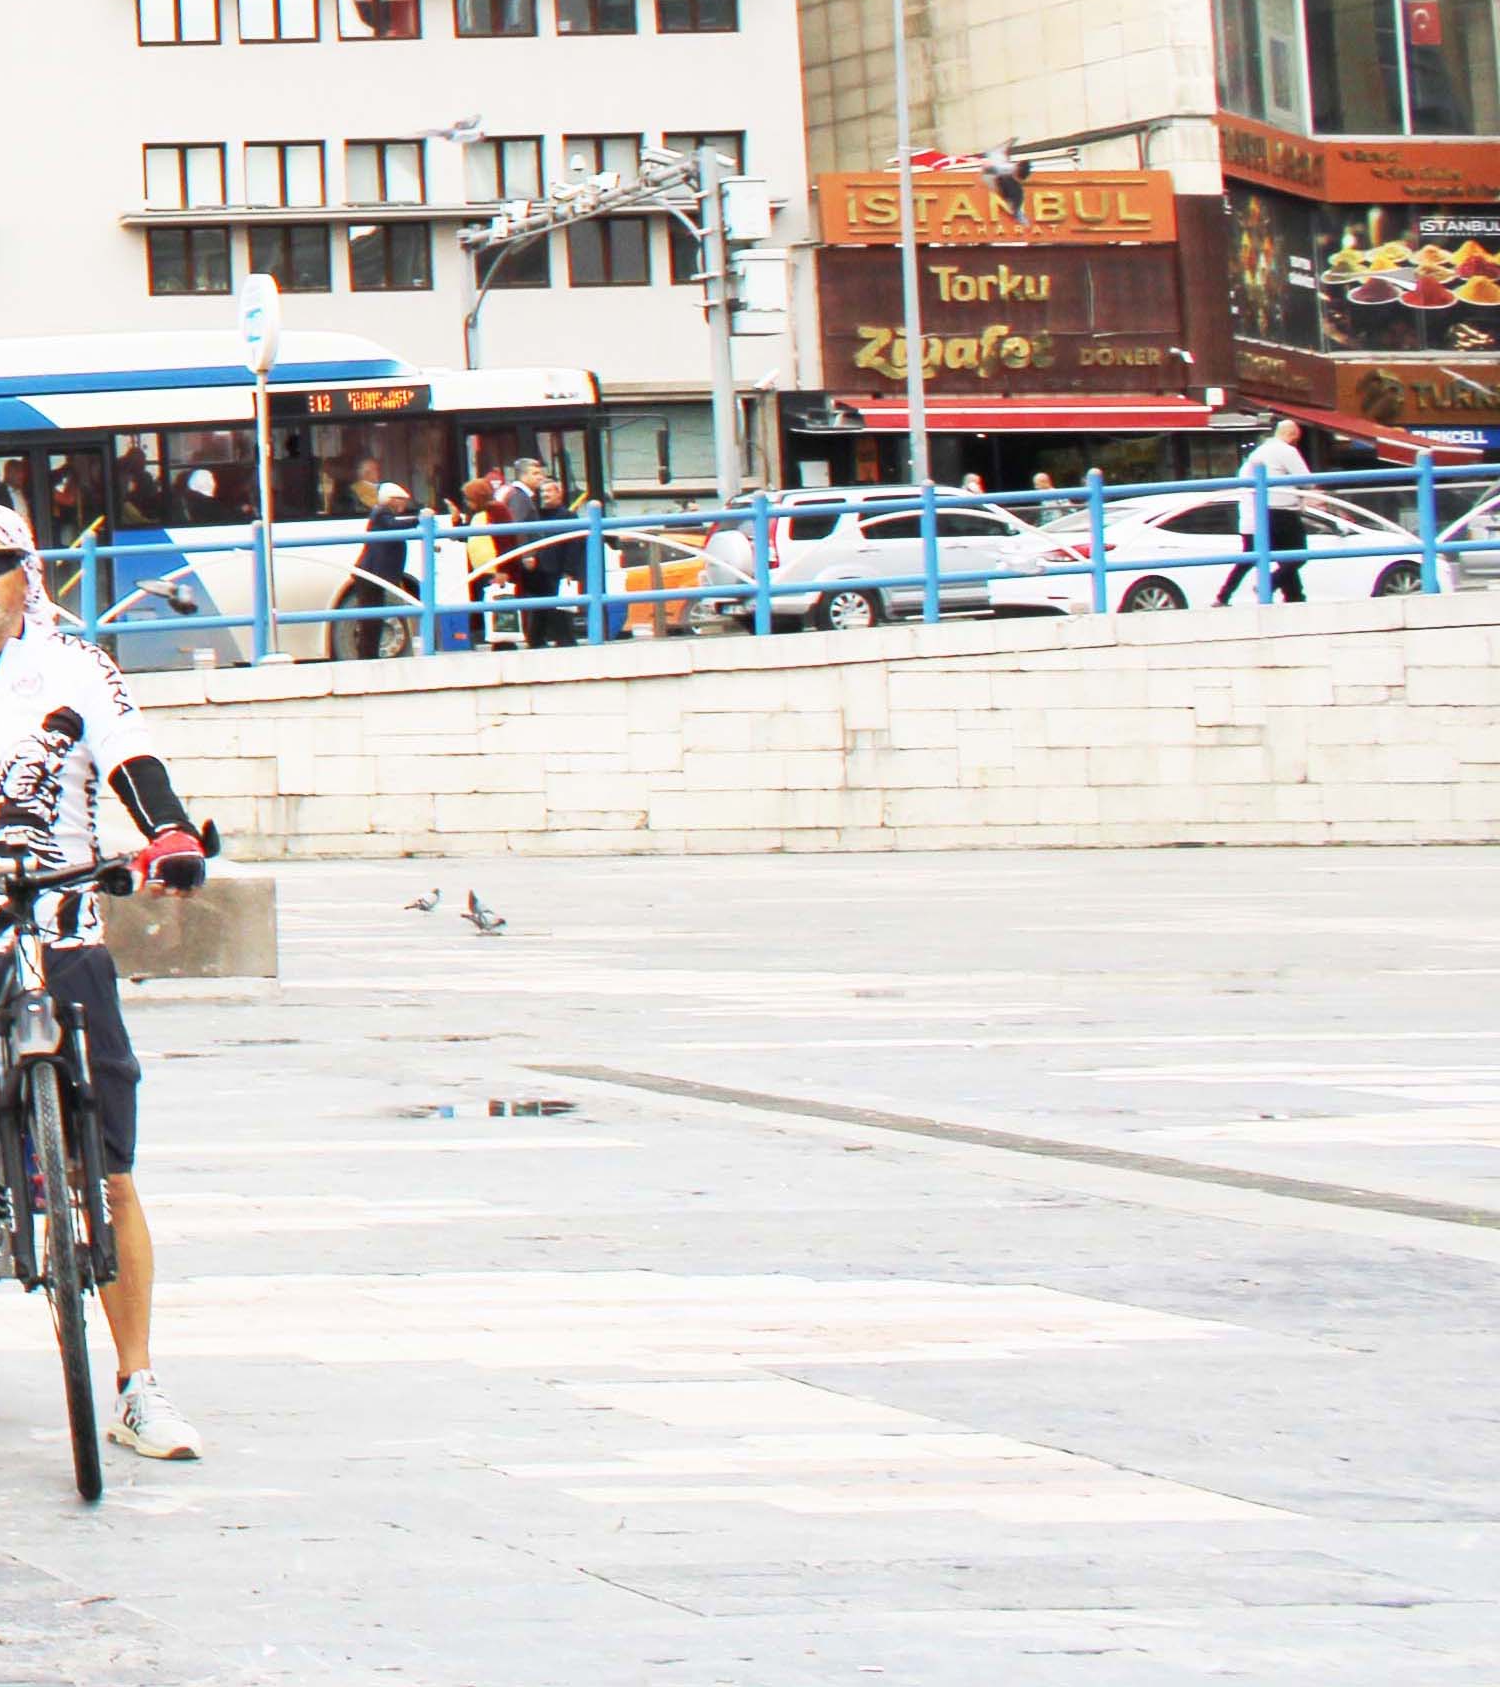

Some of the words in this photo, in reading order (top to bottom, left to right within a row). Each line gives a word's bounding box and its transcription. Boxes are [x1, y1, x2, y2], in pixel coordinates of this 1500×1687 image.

[940, 223, 1060, 237] BAHARAT
[928, 265, 1052, 302] Torku
[1078, 346, 1163, 366] DÖNER
